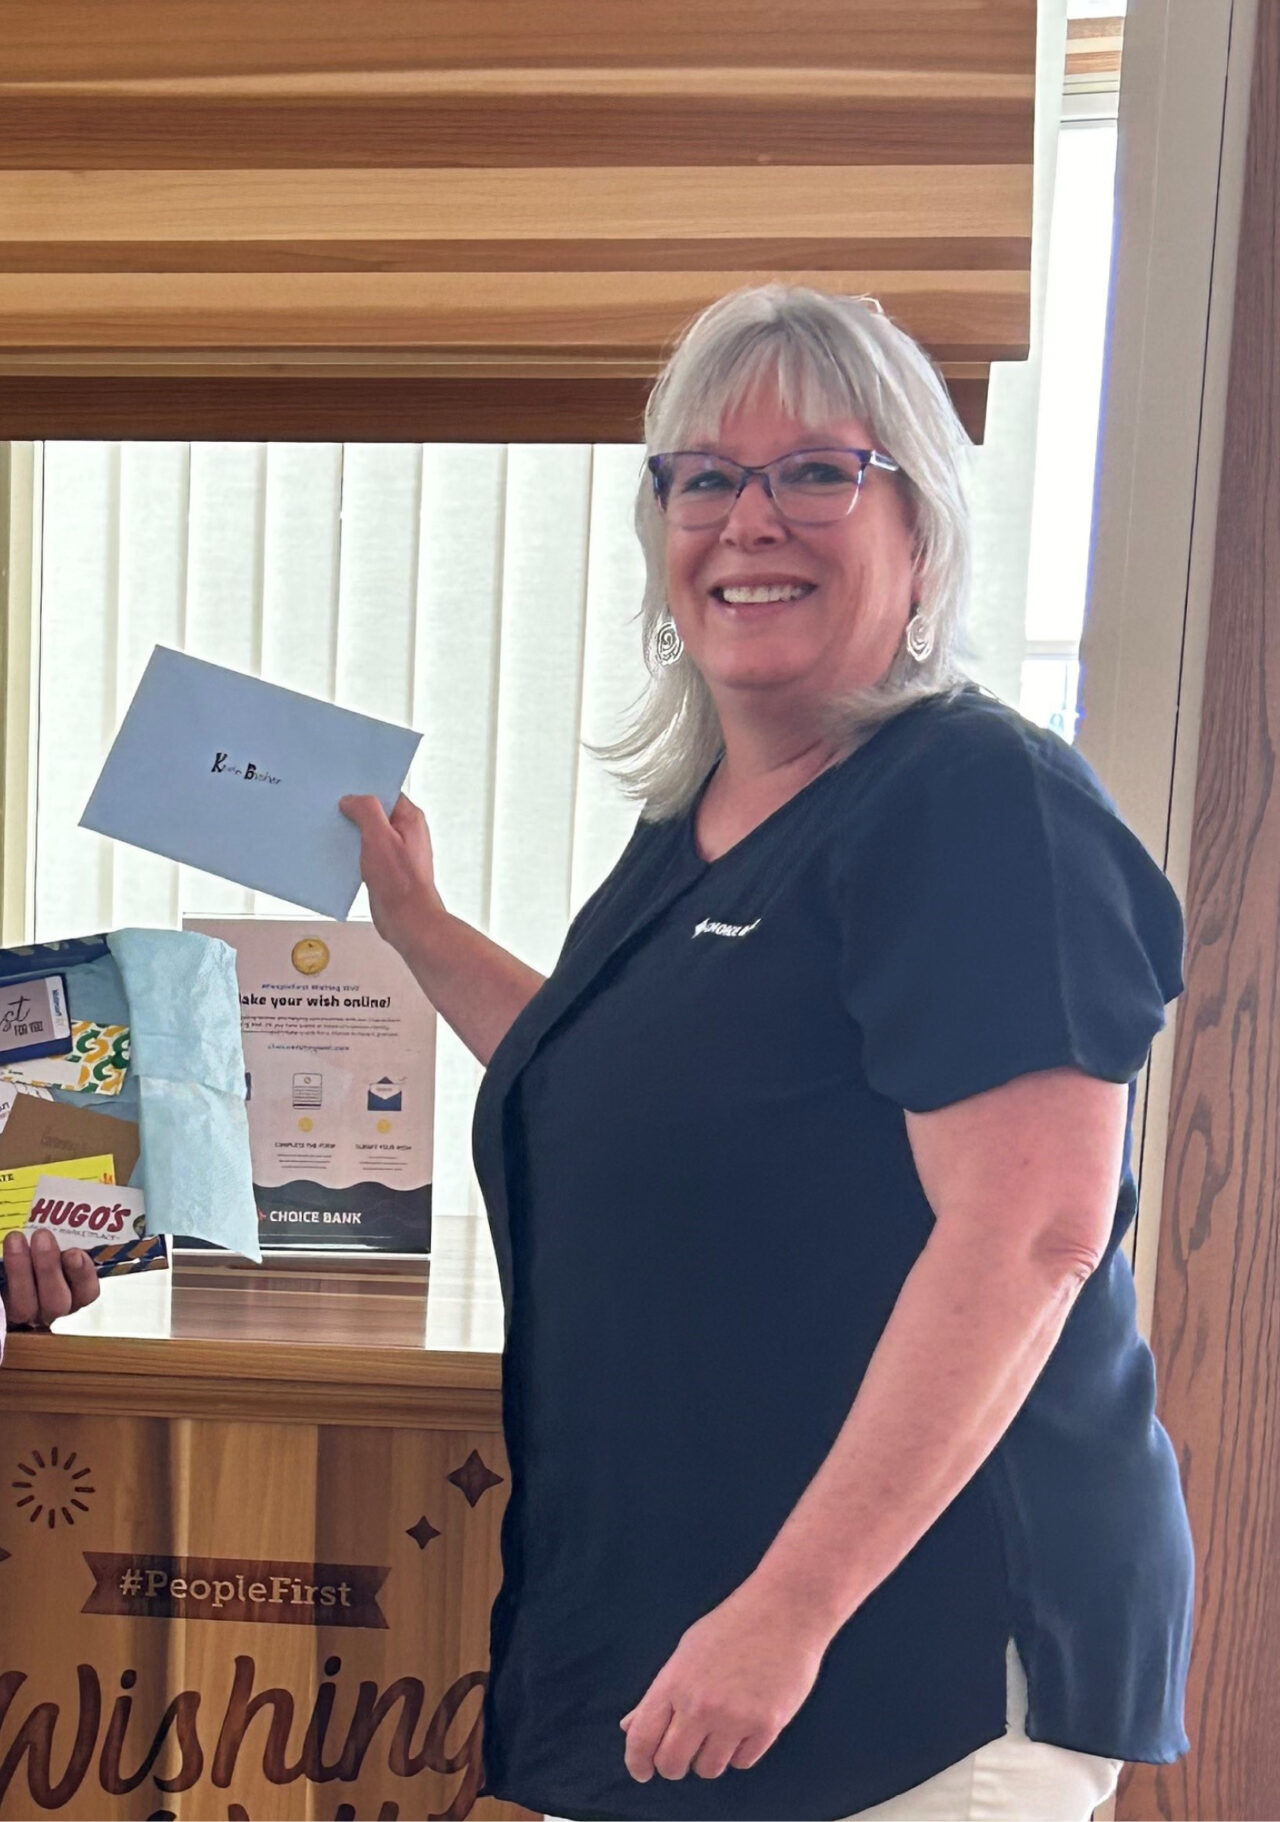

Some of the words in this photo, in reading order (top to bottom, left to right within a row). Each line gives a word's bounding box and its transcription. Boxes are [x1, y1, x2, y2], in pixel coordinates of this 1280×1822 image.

[239, 993, 267, 1006] ake
[271, 996, 302, 1009] your
[306, 994, 340, 1008] wish
[28, 1198, 131, 1233] HUGO'S
[269, 1210, 320, 1223] CHOICE
[322, 1211, 362, 1224] BANK
[119, 1567, 352, 1608] #PeopleFirst
